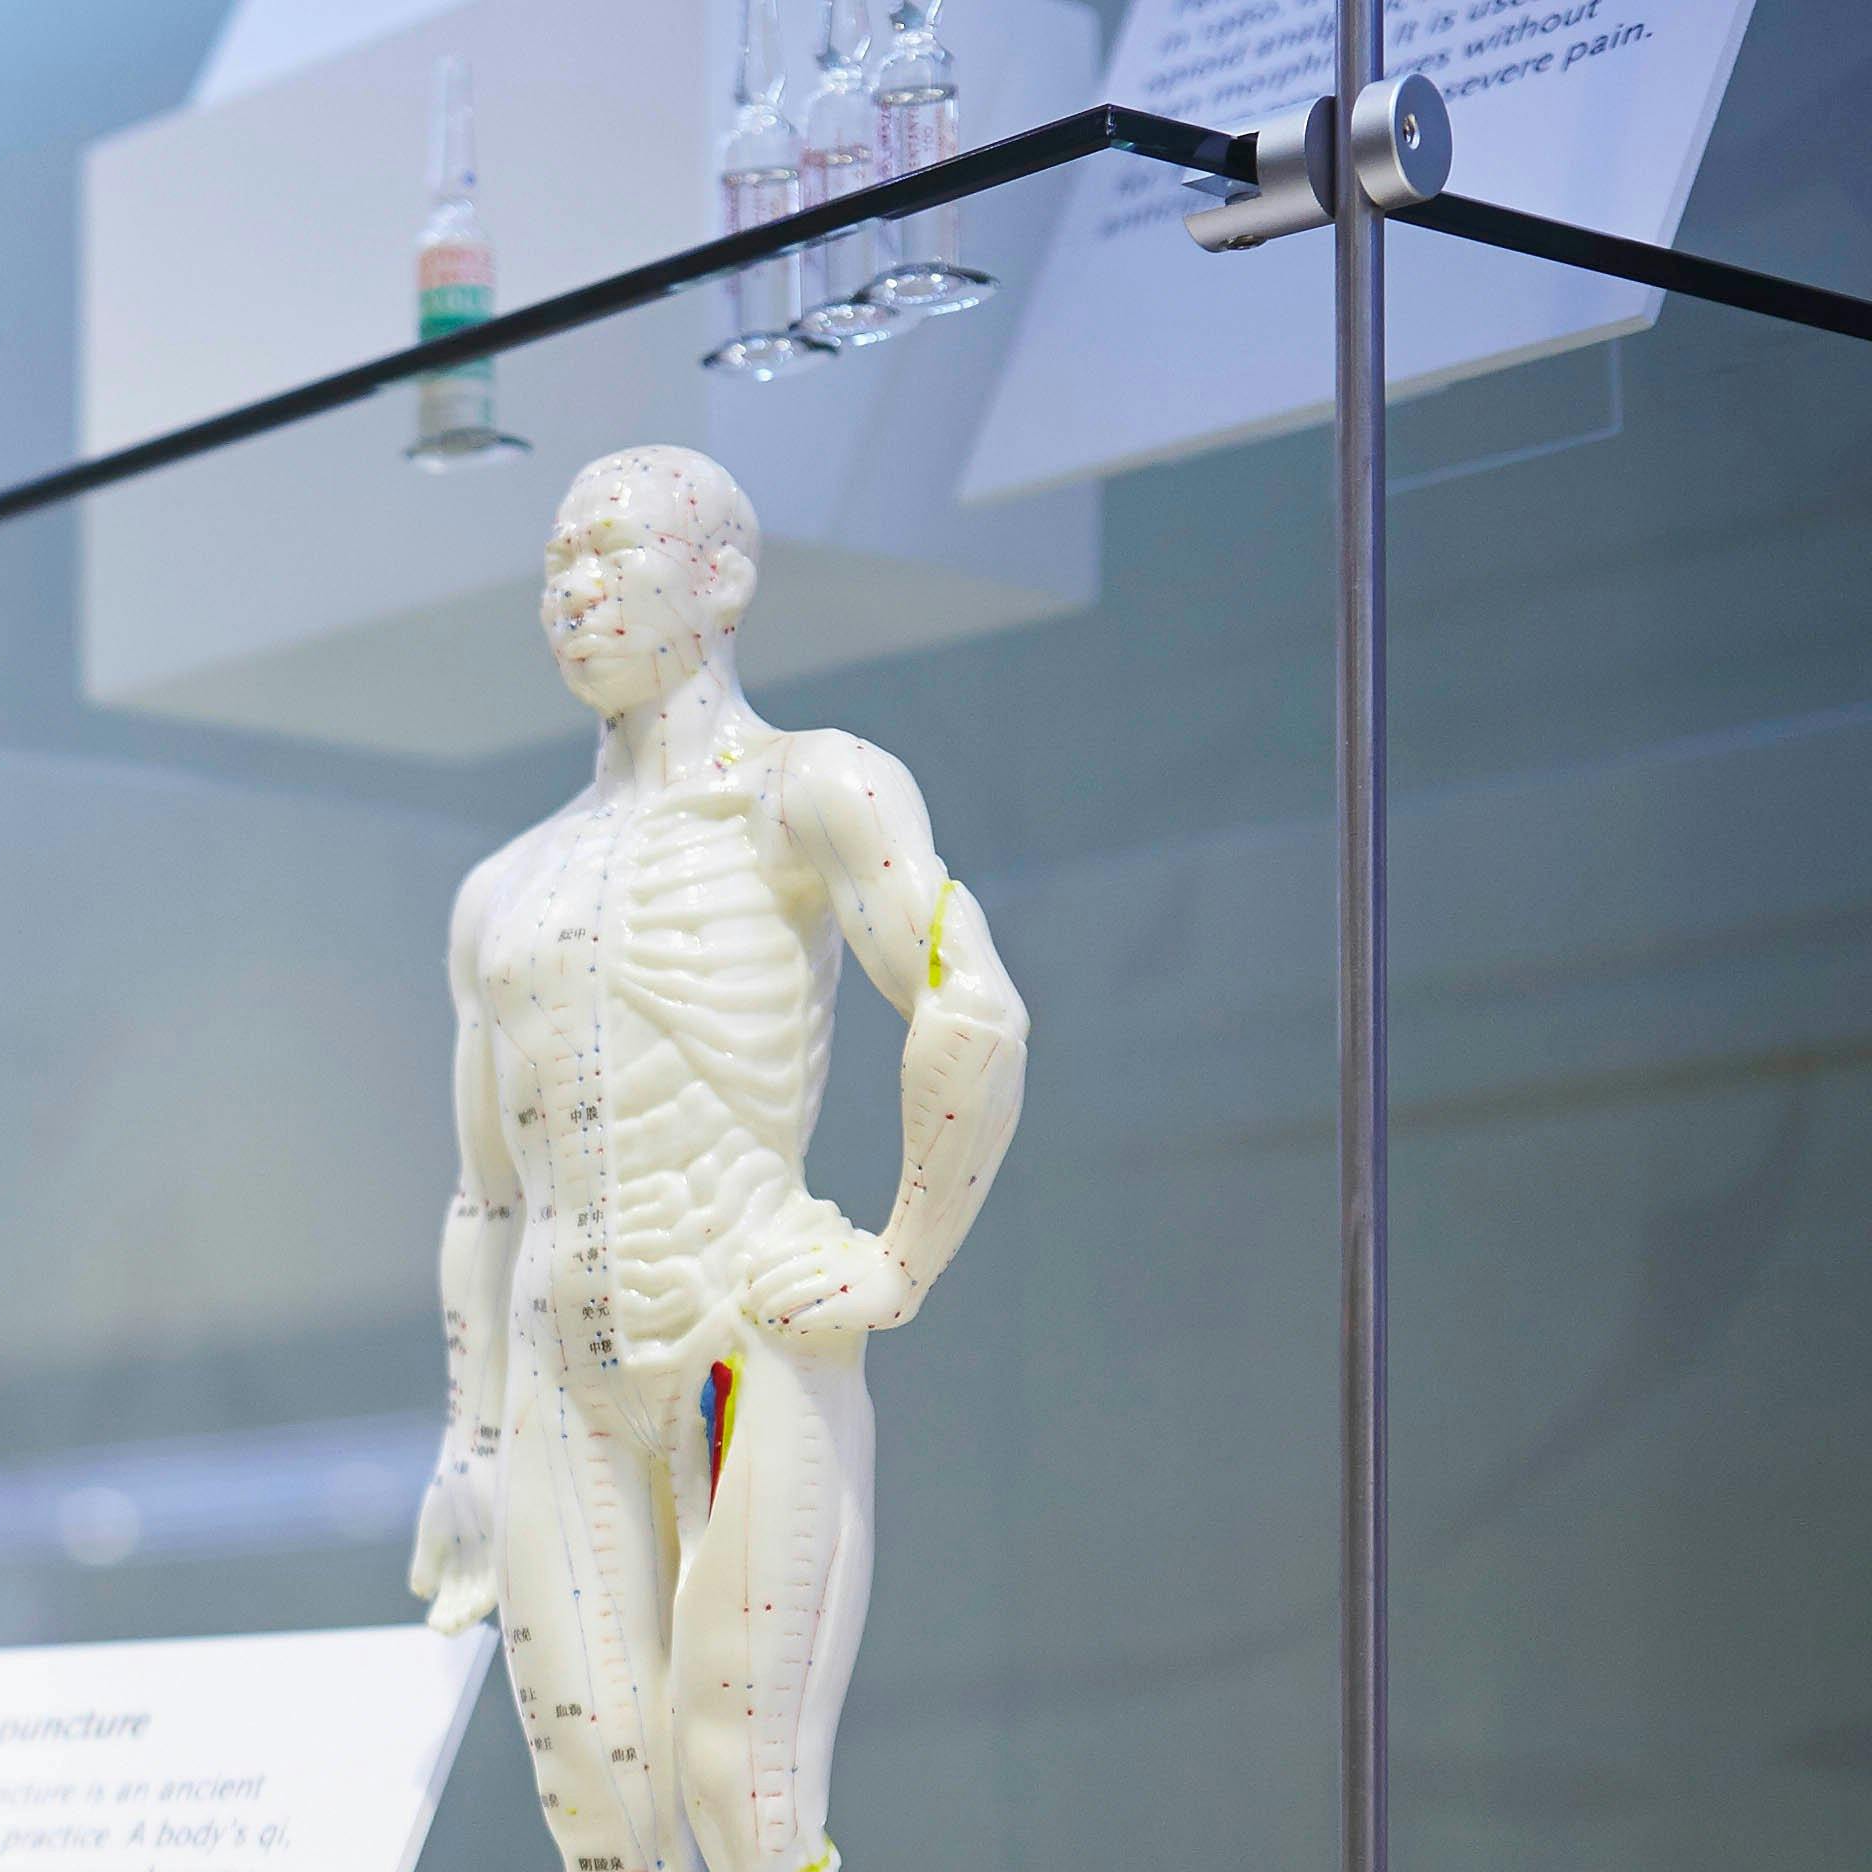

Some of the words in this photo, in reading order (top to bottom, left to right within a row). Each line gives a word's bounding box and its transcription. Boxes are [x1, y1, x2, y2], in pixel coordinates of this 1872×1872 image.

[1463, 0, 1601, 58] without
[1444, 52, 1554, 99] severe
[1562, 22, 1653, 72] pain.
[87, 1778, 104, 1801] is
[115, 1782, 149, 1801] an
[160, 1773, 266, 1801] ancient
[127, 1820, 145, 1848] A
